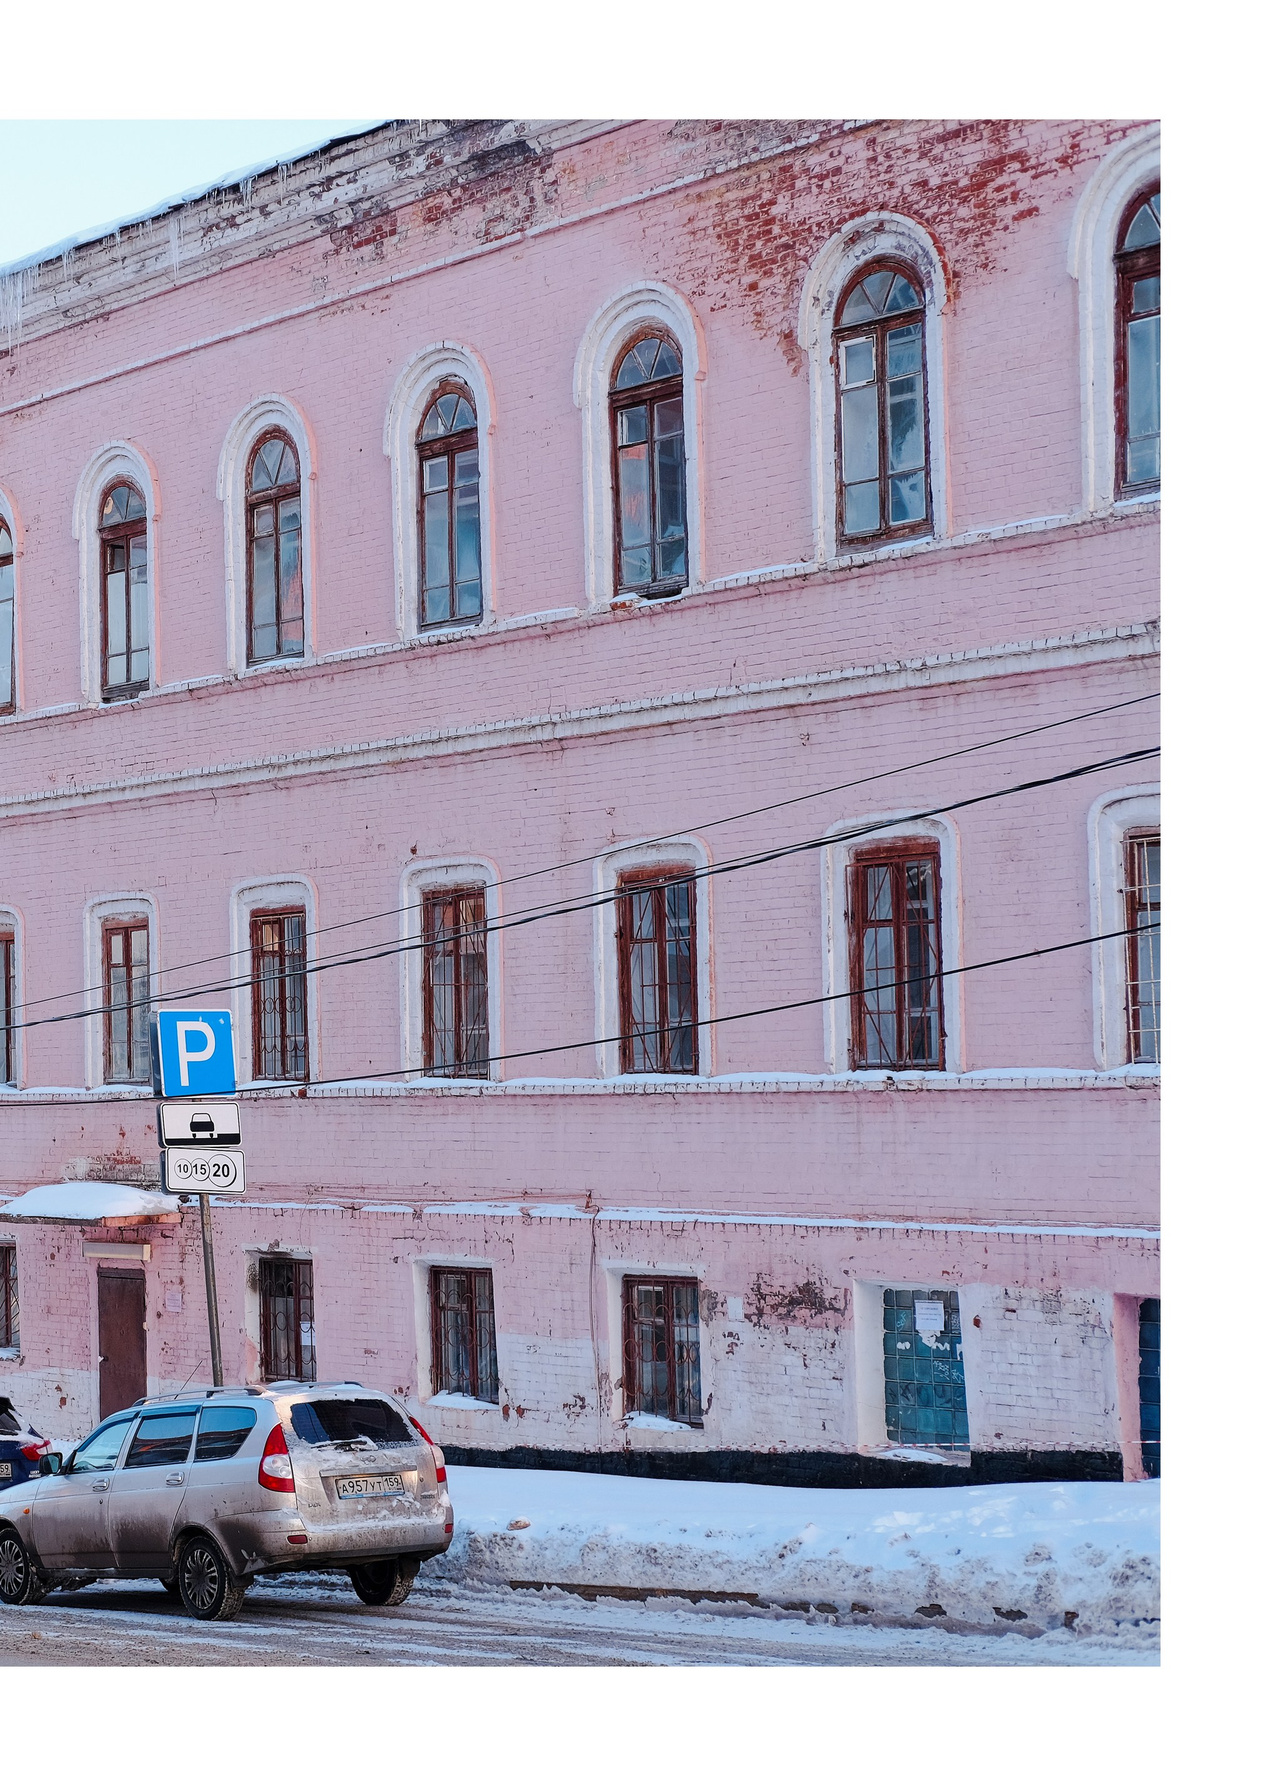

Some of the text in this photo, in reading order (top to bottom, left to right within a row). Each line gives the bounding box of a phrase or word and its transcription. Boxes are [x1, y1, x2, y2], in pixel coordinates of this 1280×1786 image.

[176, 1021, 216, 1087] P
[177, 1163, 230, 1178] 10 15 20
